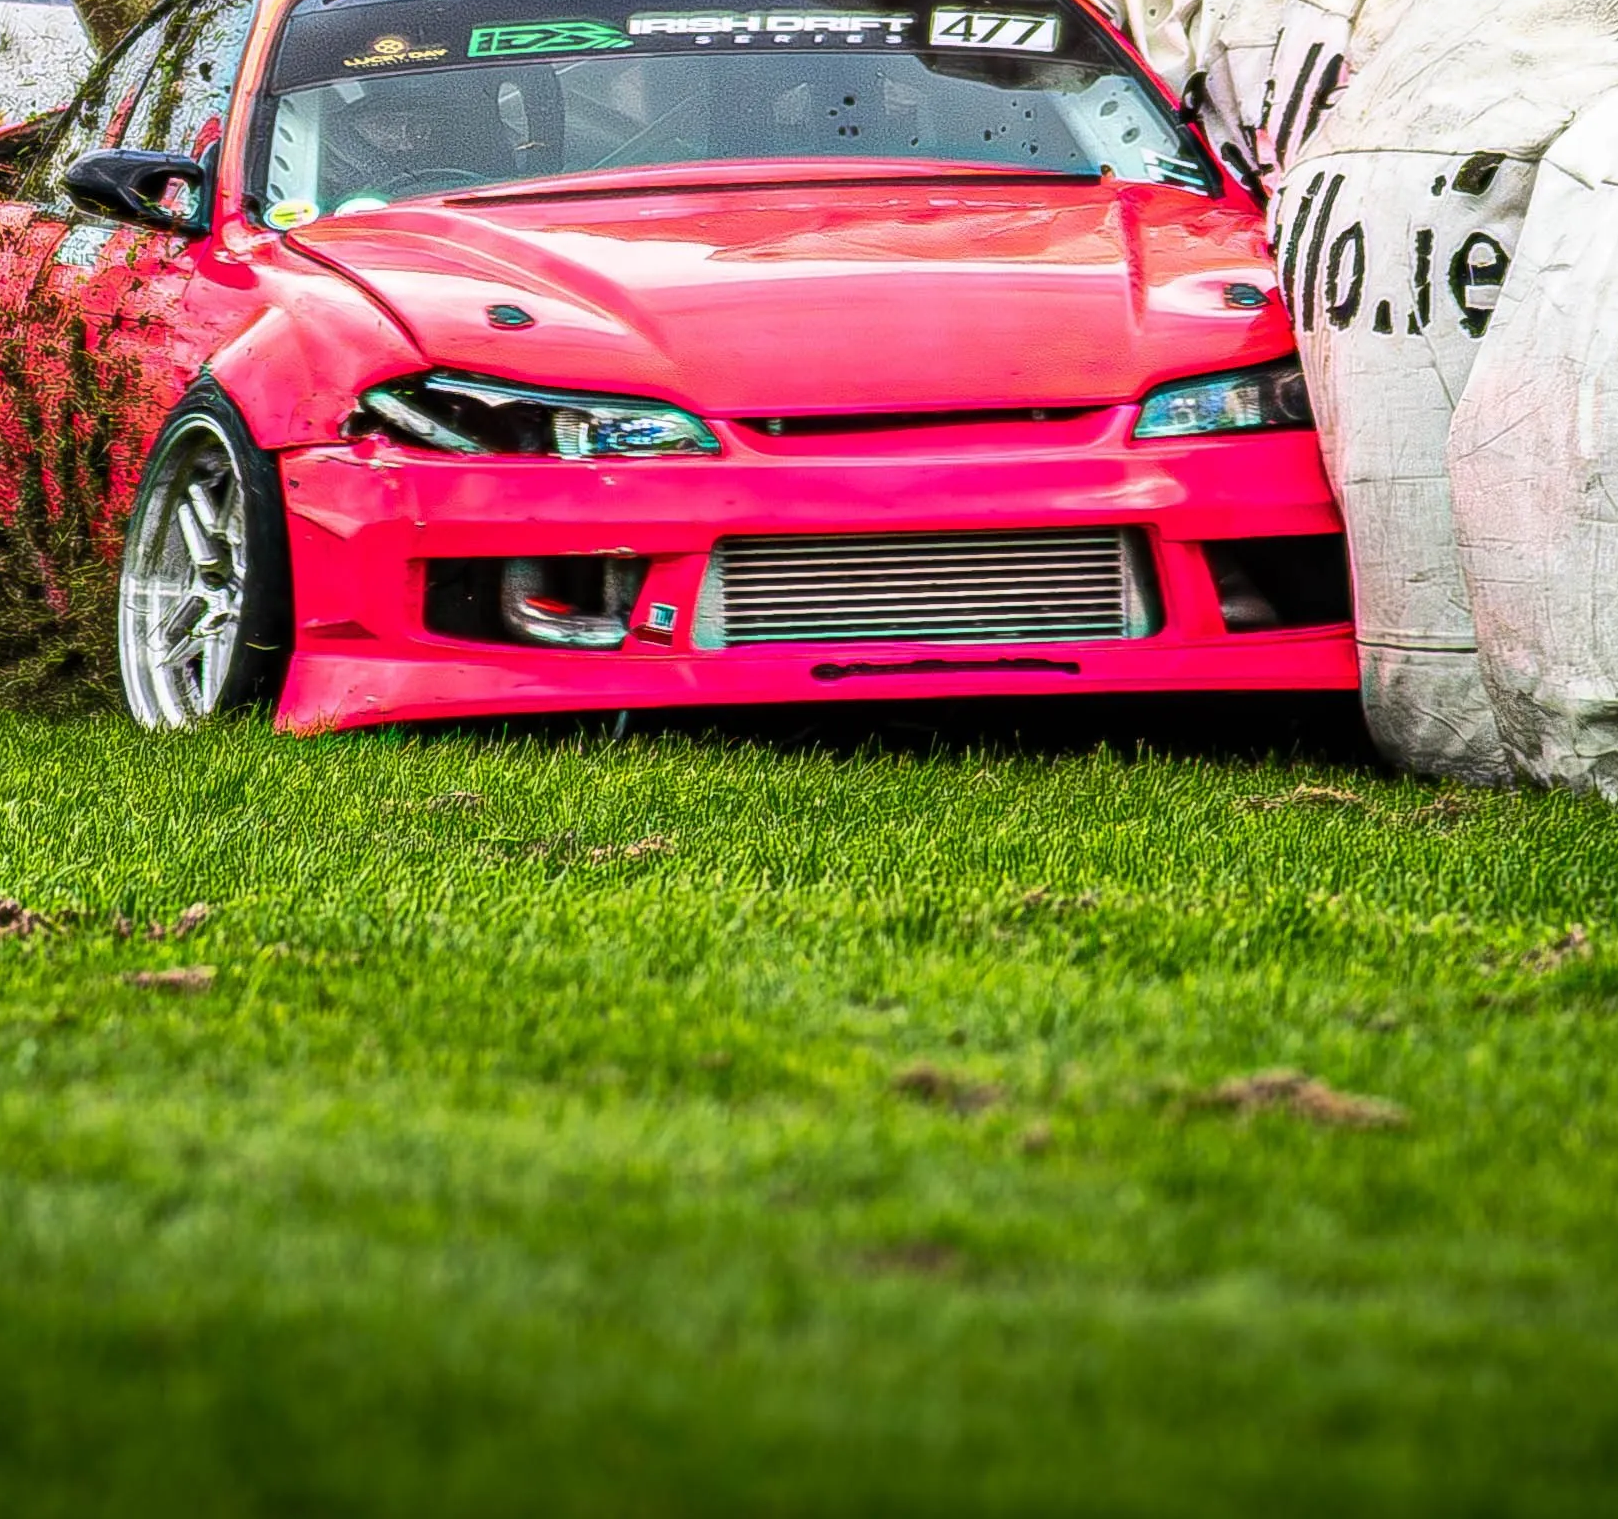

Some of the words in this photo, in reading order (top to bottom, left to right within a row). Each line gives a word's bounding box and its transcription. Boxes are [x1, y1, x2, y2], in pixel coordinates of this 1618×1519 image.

[628, 15, 760, 35] IRISH
[766, 15, 914, 32] DRIFT
[938, 14, 1046, 46] 477
[694, 34, 902, 45] SERIES
